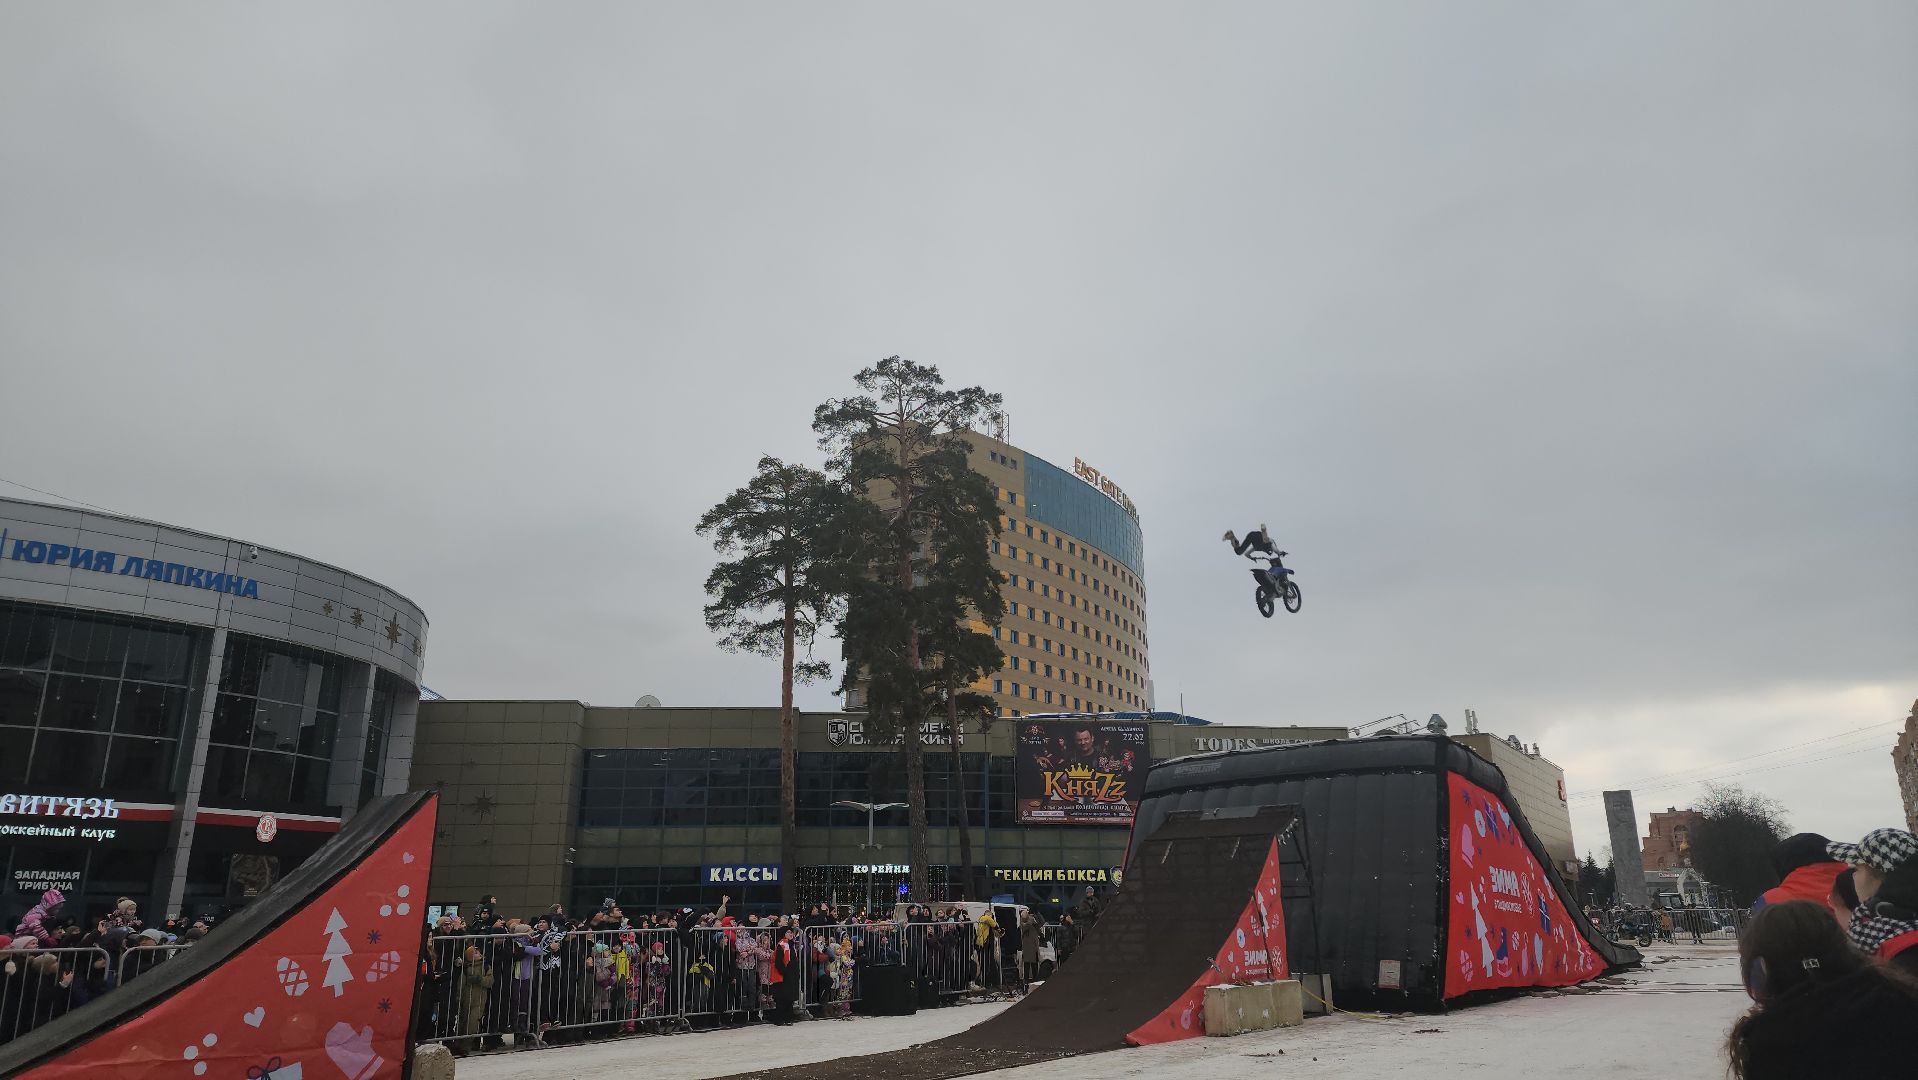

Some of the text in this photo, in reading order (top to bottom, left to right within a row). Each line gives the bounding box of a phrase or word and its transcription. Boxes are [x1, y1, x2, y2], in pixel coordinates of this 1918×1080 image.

[1075, 456, 1100, 486] EAST
[12, 539, 259, 600] ЮРИЯ ЛЯПКИНА
[1193, 737, 1257, 751] TODES
[14, 870, 81, 881] ЗАПАДНАЯ
[709, 867, 778, 881] КАССЫ
[1056, 869, 1107, 882] БОКСА
[18, 881, 73, 891] ТРИБУНА
[1488, 865, 1521, 898] ЗИМА
